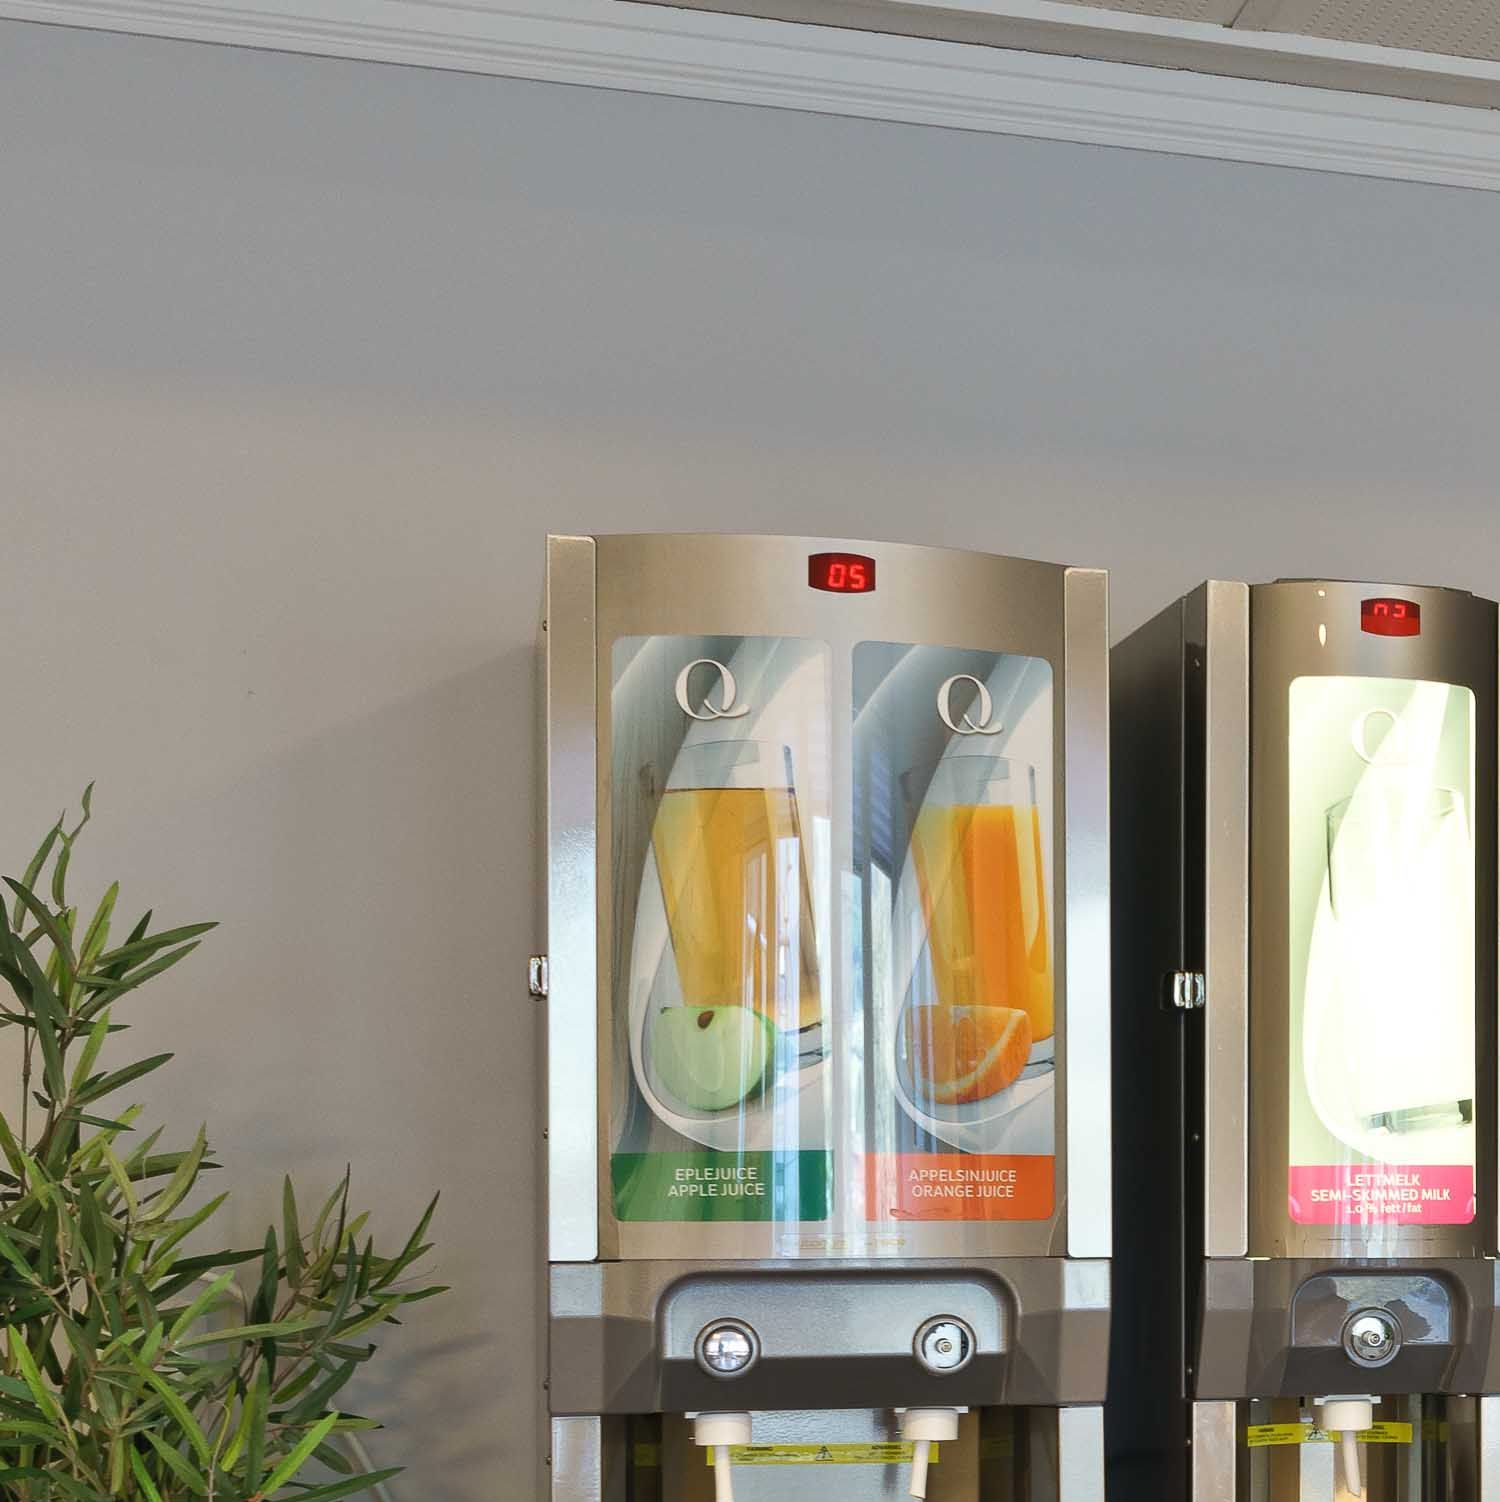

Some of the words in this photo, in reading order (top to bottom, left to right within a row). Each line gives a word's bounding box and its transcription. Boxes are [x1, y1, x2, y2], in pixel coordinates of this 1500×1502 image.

[828, 563, 866, 590] 05
[675, 659, 750, 721] Q
[936, 674, 1003, 735] Q
[675, 1167, 758, 1181] EPLEJUICE
[909, 1169, 1017, 1182] APPELSINJUICE
[1346, 1173, 1421, 1187] LETTMELK
[667, 1184, 718, 1197] APPLE
[720, 1183, 766, 1196] JUICE
[911, 1185, 974, 1198] ORANGE
[976, 1185, 1014, 1198] JUICE
[1311, 1189, 1419, 1202] SEMI-SKIMMED
[1421, 1188, 1451, 1201] MILK
